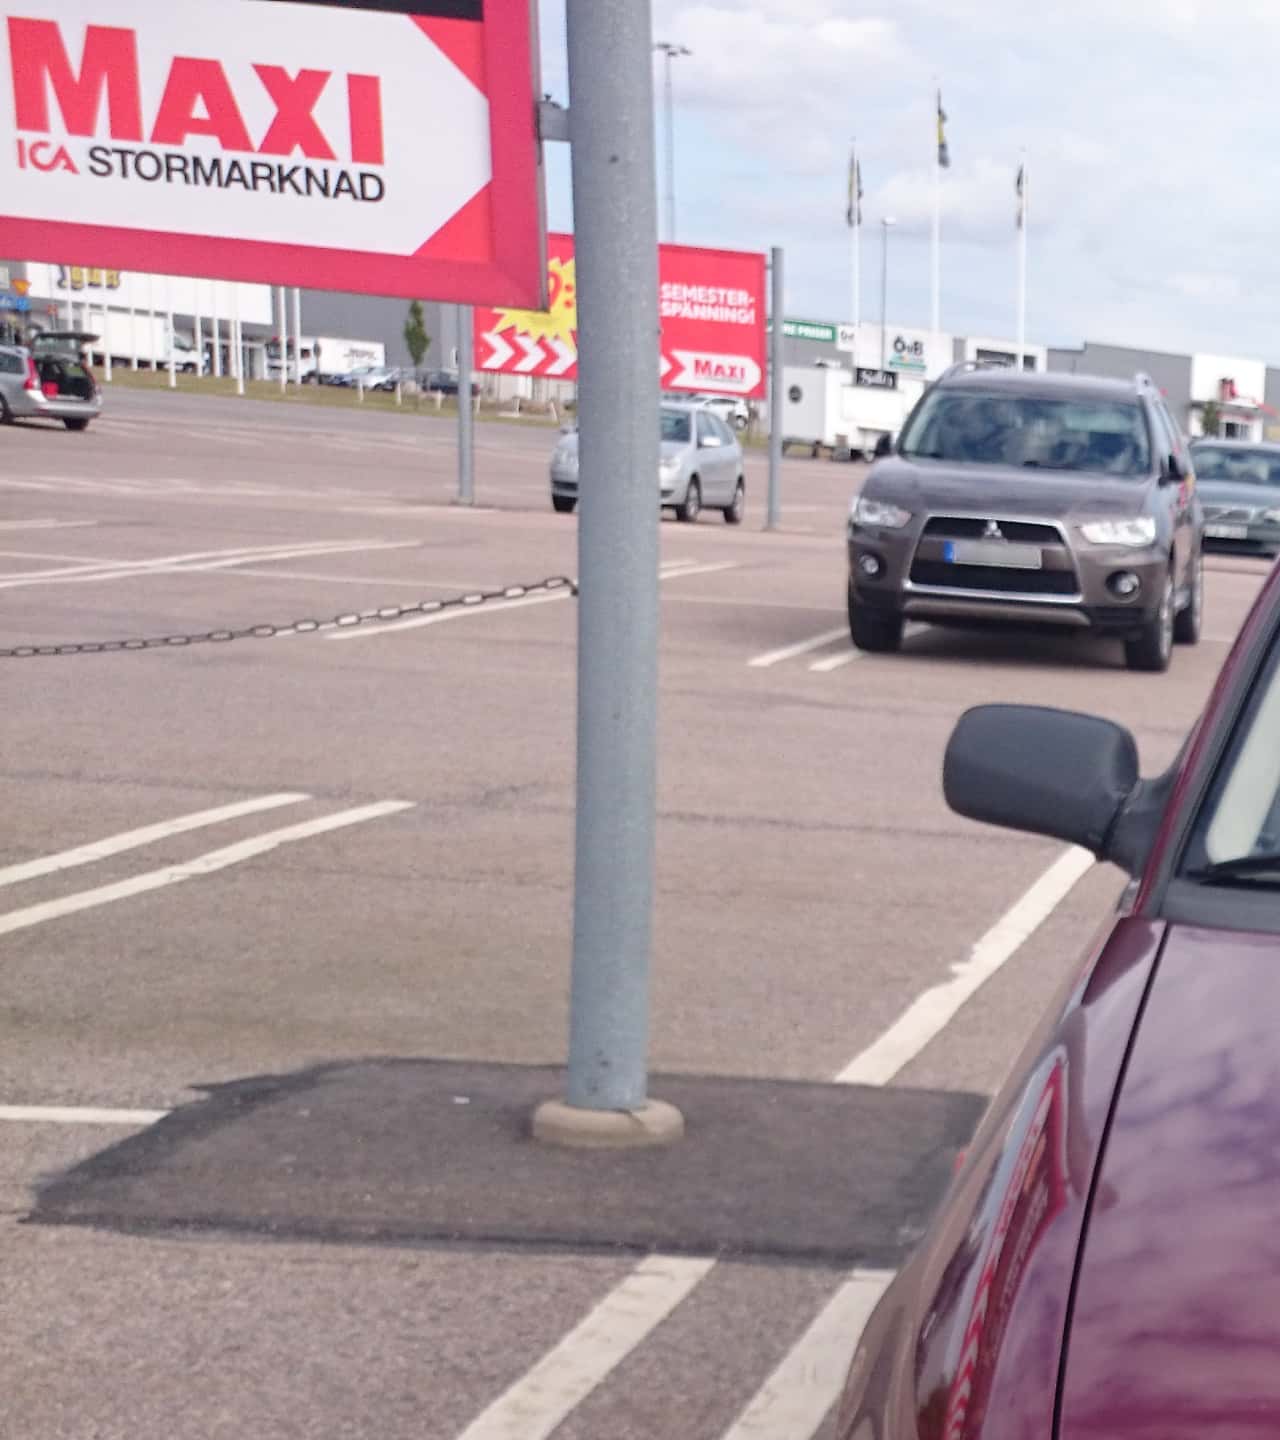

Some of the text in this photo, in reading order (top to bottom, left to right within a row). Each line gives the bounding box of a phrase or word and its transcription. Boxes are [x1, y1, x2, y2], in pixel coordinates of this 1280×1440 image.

[7, 16, 385, 165] MAXI
[16, 138, 386, 203] ICA STORMARKNAD
[660, 282, 755, 307] SEMESTER-
[694, 359, 746, 378] MAXI
